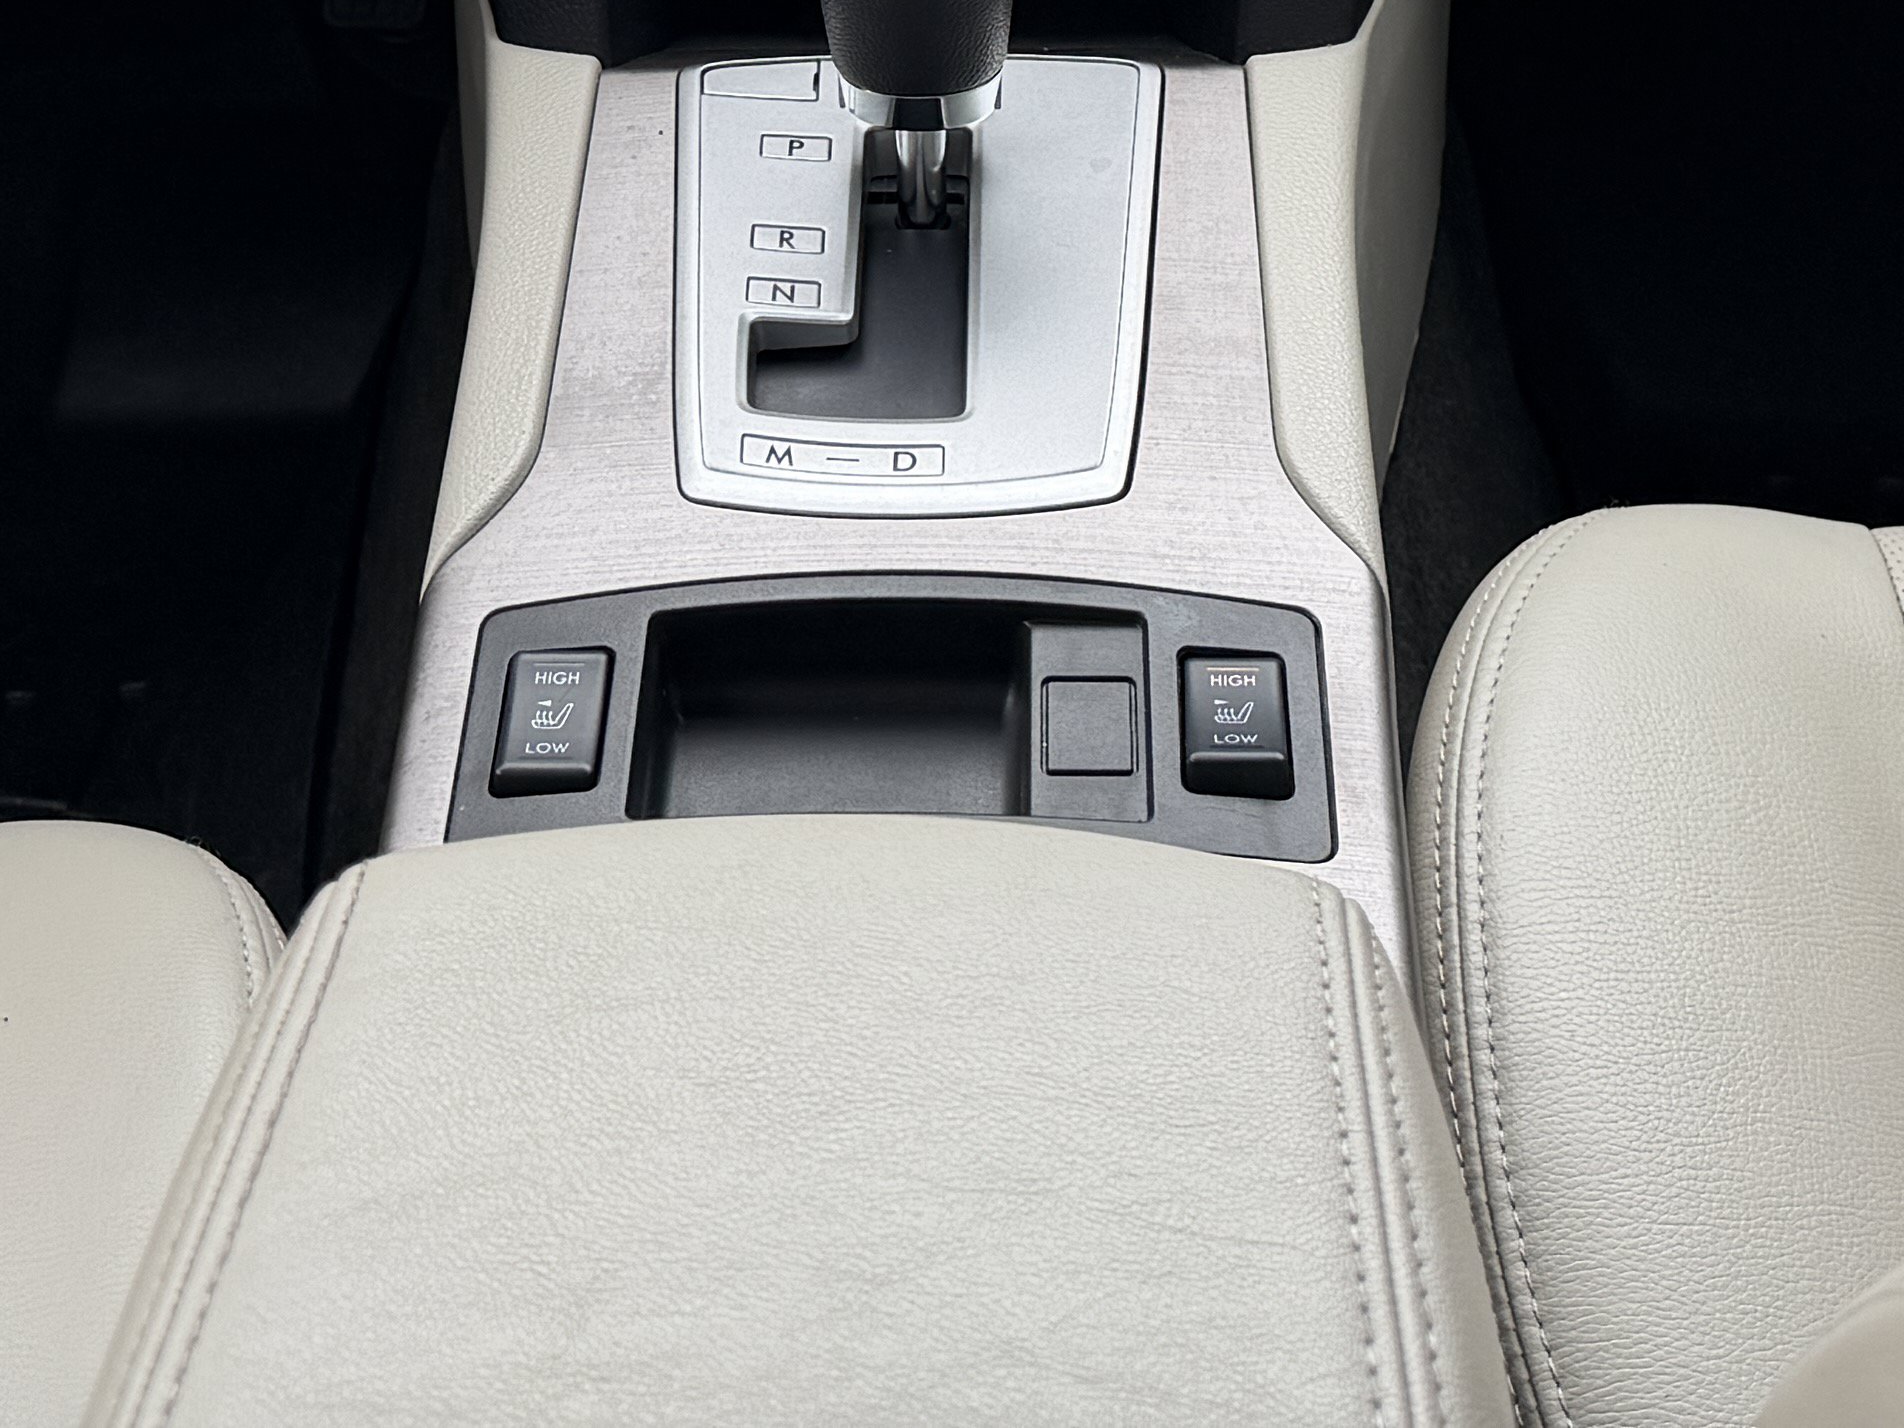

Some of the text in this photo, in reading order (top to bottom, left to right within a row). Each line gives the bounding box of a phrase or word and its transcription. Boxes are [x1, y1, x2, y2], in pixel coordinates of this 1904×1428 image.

[788, 139, 804, 156] P
[779, 230, 796, 248] R
[772, 284, 795, 303] N
[765, 445, 917, 471] M D
[534, 671, 580, 685] HIGH
[1210, 674, 1256, 687] HIGH
[1213, 733, 1258, 744] LOW
[525, 742, 570, 754] LOW
